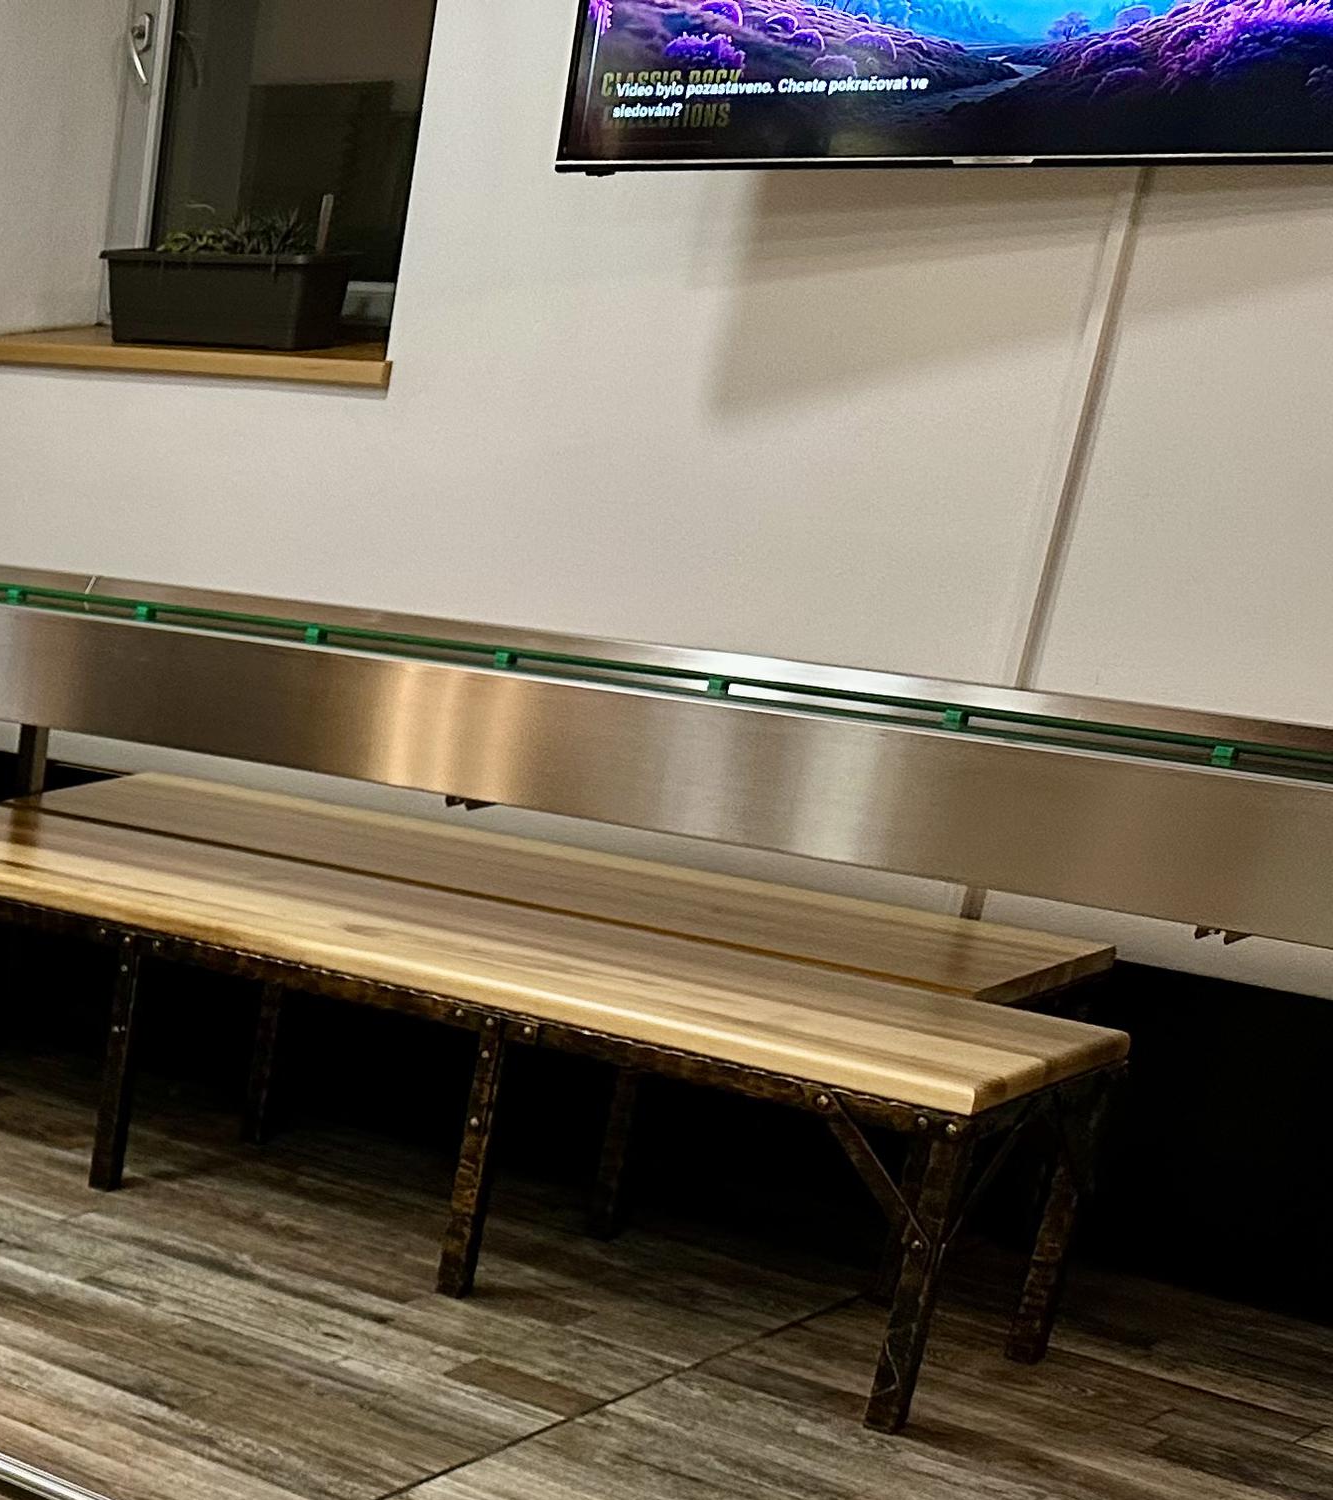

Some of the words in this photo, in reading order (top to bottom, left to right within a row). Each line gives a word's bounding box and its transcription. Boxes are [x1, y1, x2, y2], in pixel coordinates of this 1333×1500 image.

[616, 82, 654, 97] Video
[656, 81, 684, 99] bylo
[778, 78, 827, 94] Chcete
[827, 75, 909, 96] pokračovat
[910, 77, 929, 91] ve
